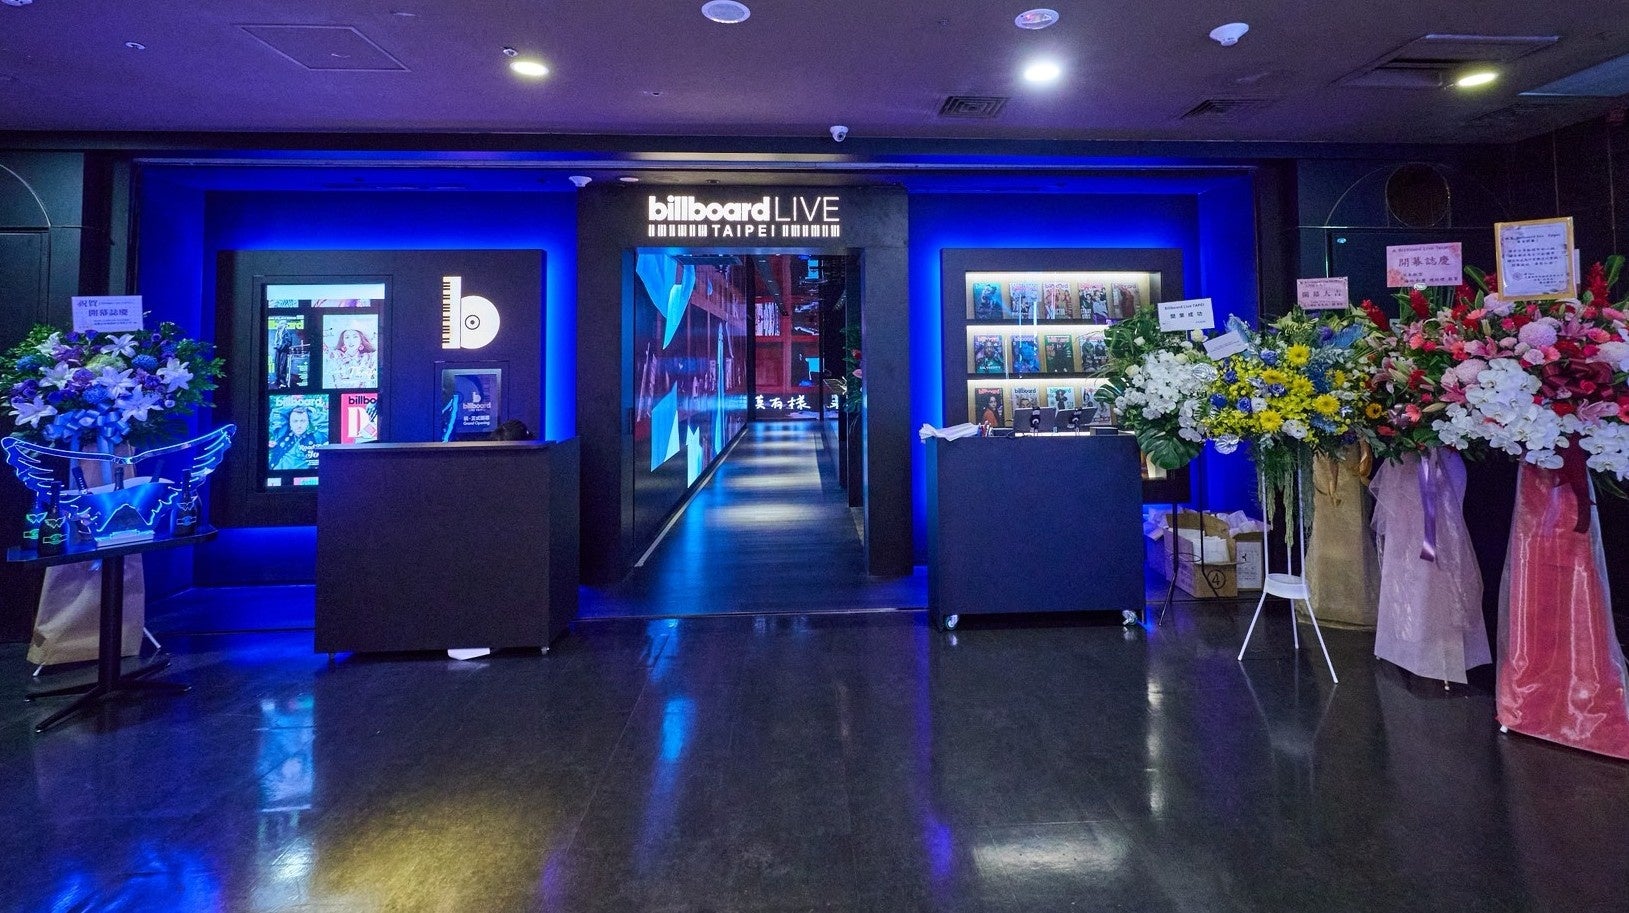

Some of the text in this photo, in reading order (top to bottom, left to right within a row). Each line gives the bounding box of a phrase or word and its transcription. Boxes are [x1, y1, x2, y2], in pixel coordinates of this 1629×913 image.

[648, 195, 840, 222] billboard LIVE
[712, 224, 775, 237] TAIPEI
[1398, 256, 1450, 267] 開幕誌慶
[276, 398, 324, 406] billboard
[463, 401, 491, 409] billboard
